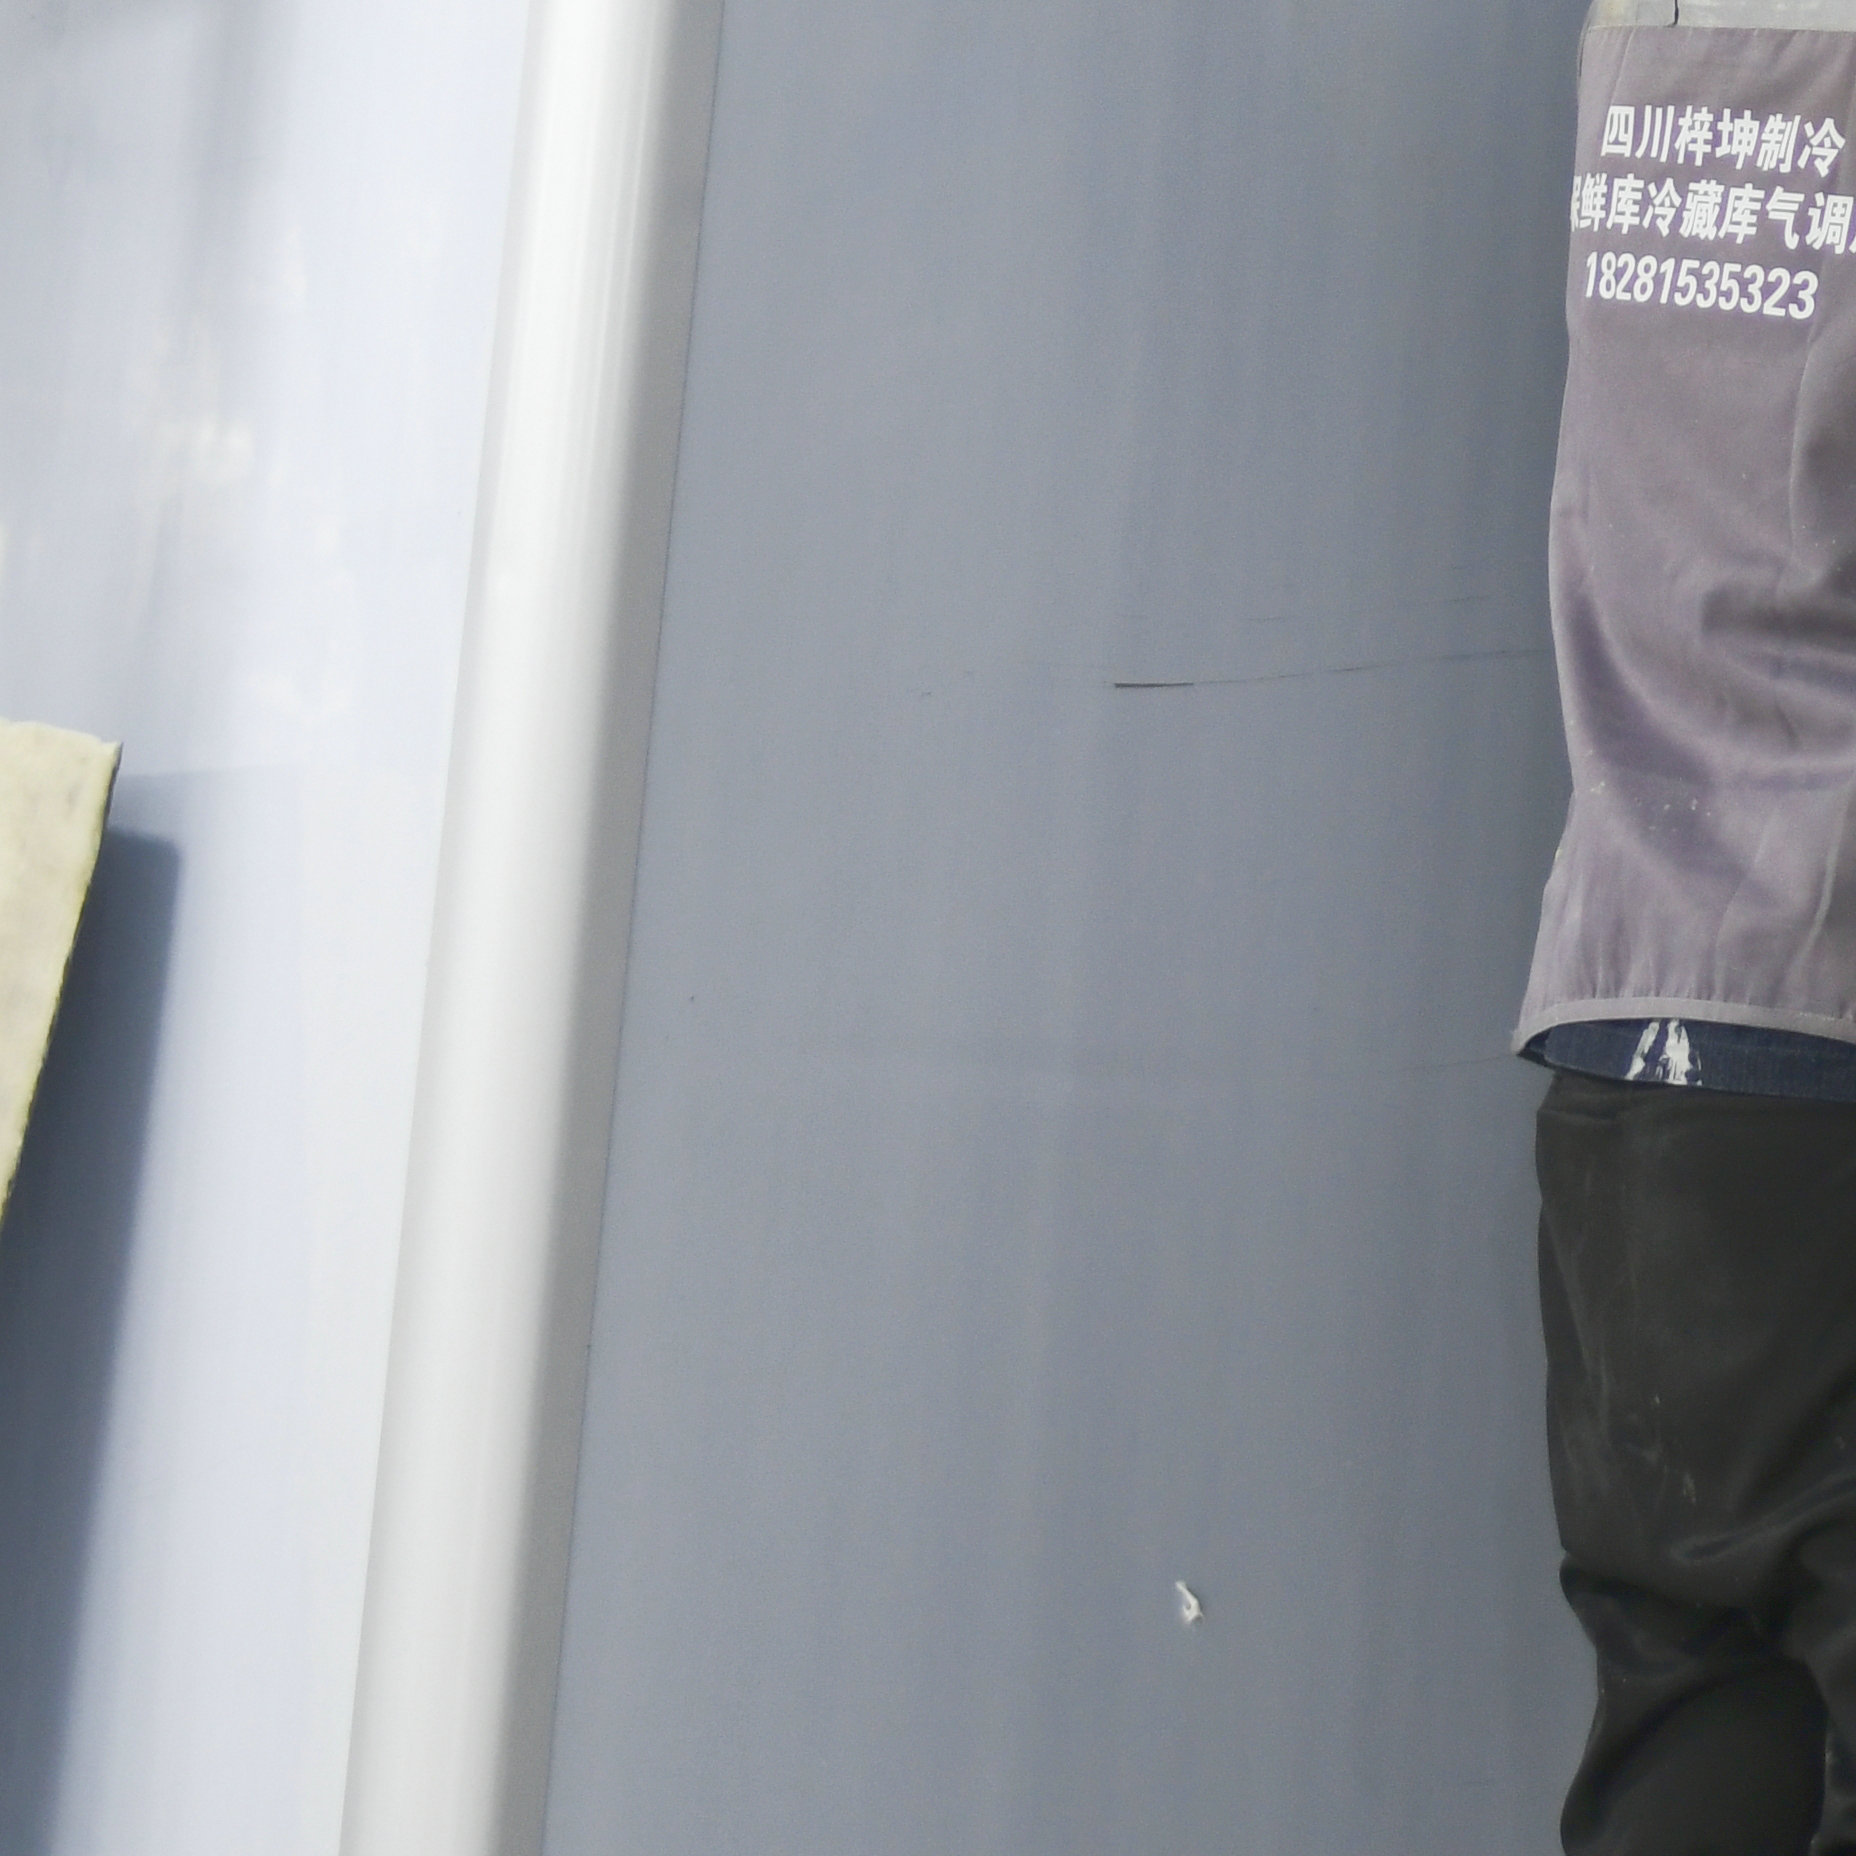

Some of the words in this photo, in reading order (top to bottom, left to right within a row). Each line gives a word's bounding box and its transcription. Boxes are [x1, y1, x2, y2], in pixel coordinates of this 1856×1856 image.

[1601, 105, 1845, 177] 四川梓坤制冷
[1585, 252, 1819, 319] 18281535323
